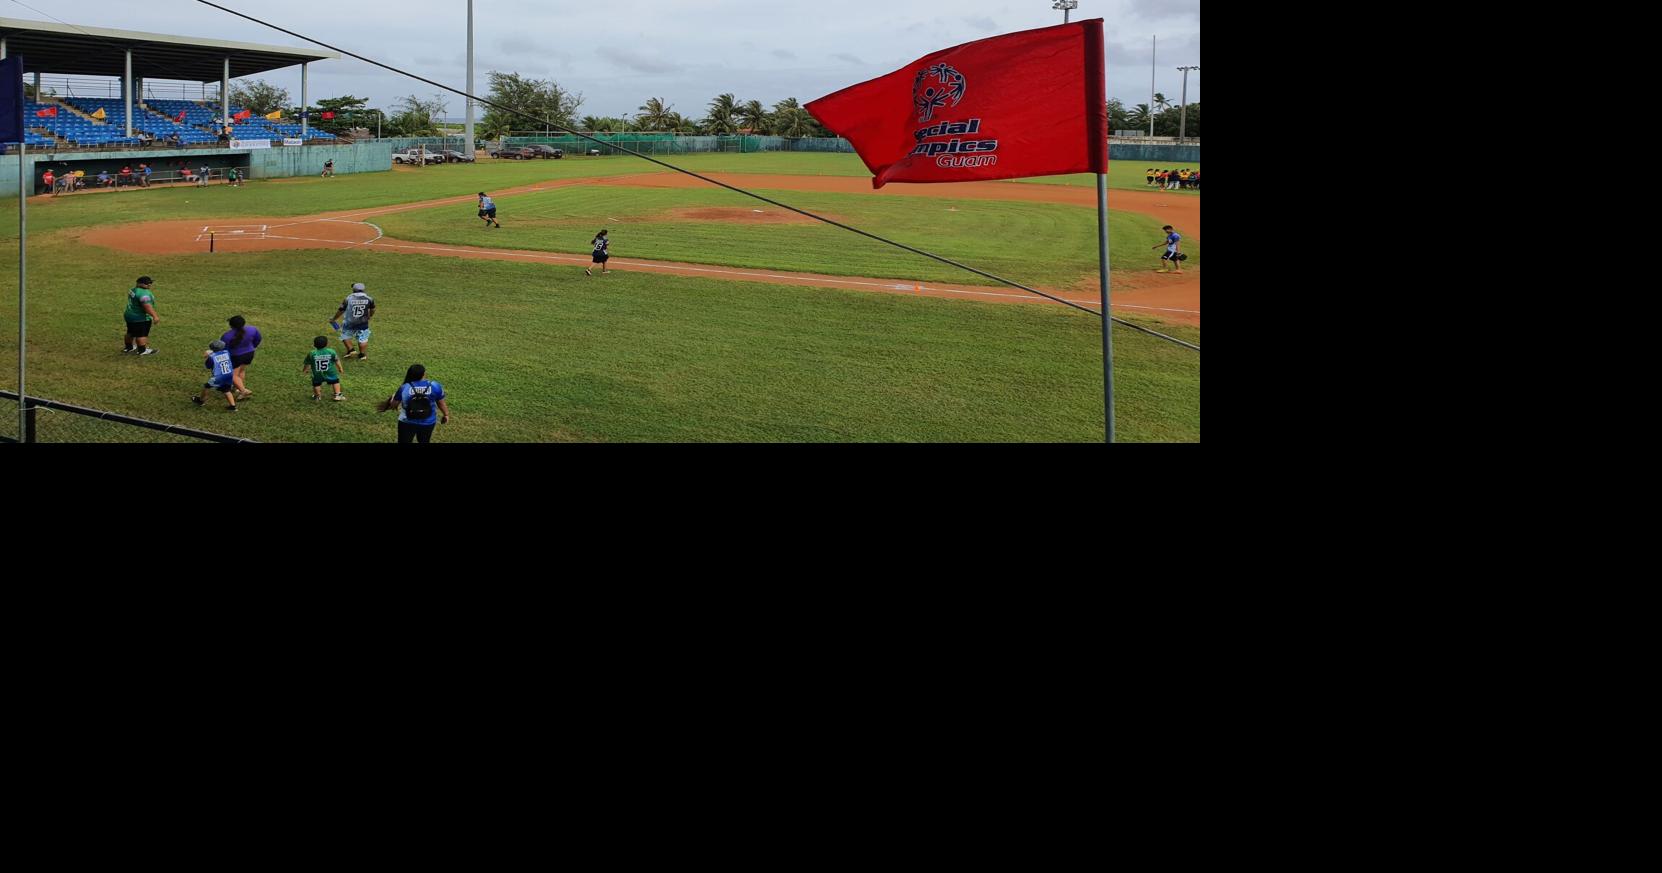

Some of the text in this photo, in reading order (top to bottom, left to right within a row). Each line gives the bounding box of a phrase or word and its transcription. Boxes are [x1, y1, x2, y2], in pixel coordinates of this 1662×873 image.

[913, 119, 980, 140] ecial
[936, 155, 998, 168] Guam
[352, 305, 366, 317] 15
[315, 359, 329, 371] 15
